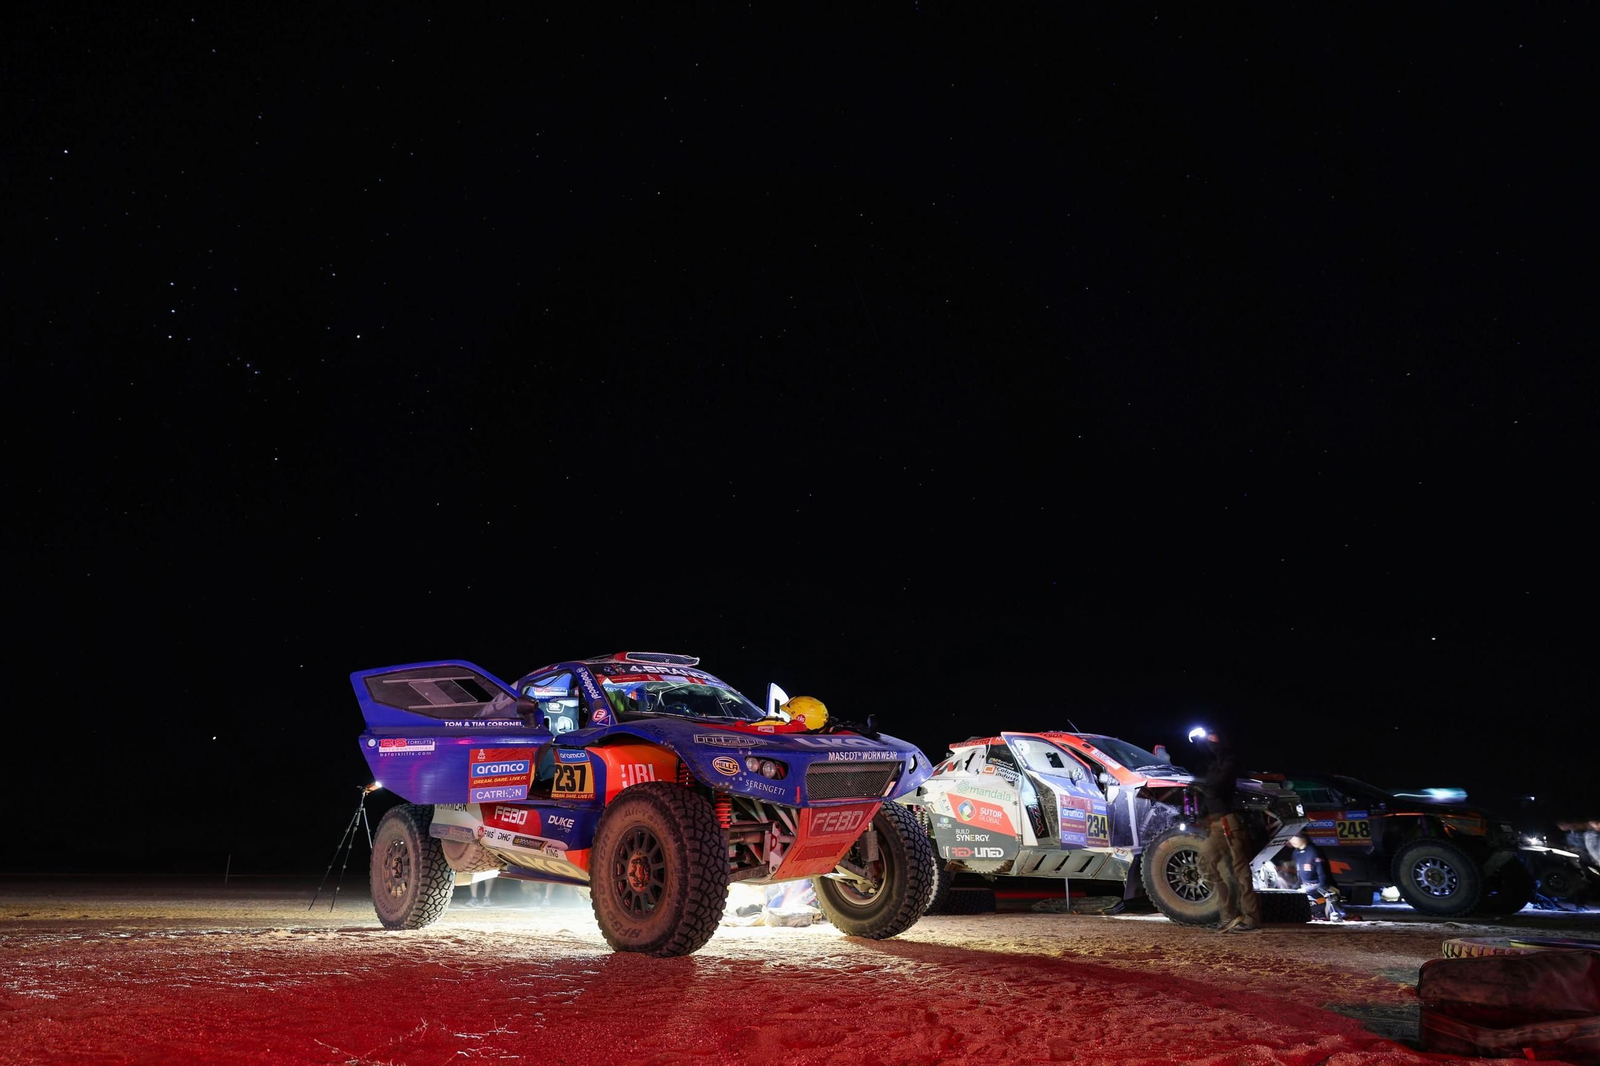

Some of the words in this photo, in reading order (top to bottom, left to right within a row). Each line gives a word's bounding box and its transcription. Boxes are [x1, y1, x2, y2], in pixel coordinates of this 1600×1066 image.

[381, 738, 408, 748] BS
[862, 752, 898, 760] WORKWEAR
[476, 763, 526, 775] aramco
[715, 761, 739, 770] HELLA
[554, 764, 587, 792] 237
[476, 787, 522, 800] CATRION
[745, 779, 786, 796] SERENGETI
[969, 786, 1012, 802] mandala
[494, 805, 529, 825] FEBO
[980, 807, 1003, 819] SUTOR
[1062, 809, 1084, 819] aramco
[547, 815, 575, 828] DUKE
[811, 810, 865, 832] FEBO
[978, 814, 1001, 825] GLOBAL
[1087, 814, 1107, 838] 234
[1337, 821, 1371, 838] 248
[955, 834, 991, 842] SYNERGY
[951, 846, 1004, 858] RED-LINED
